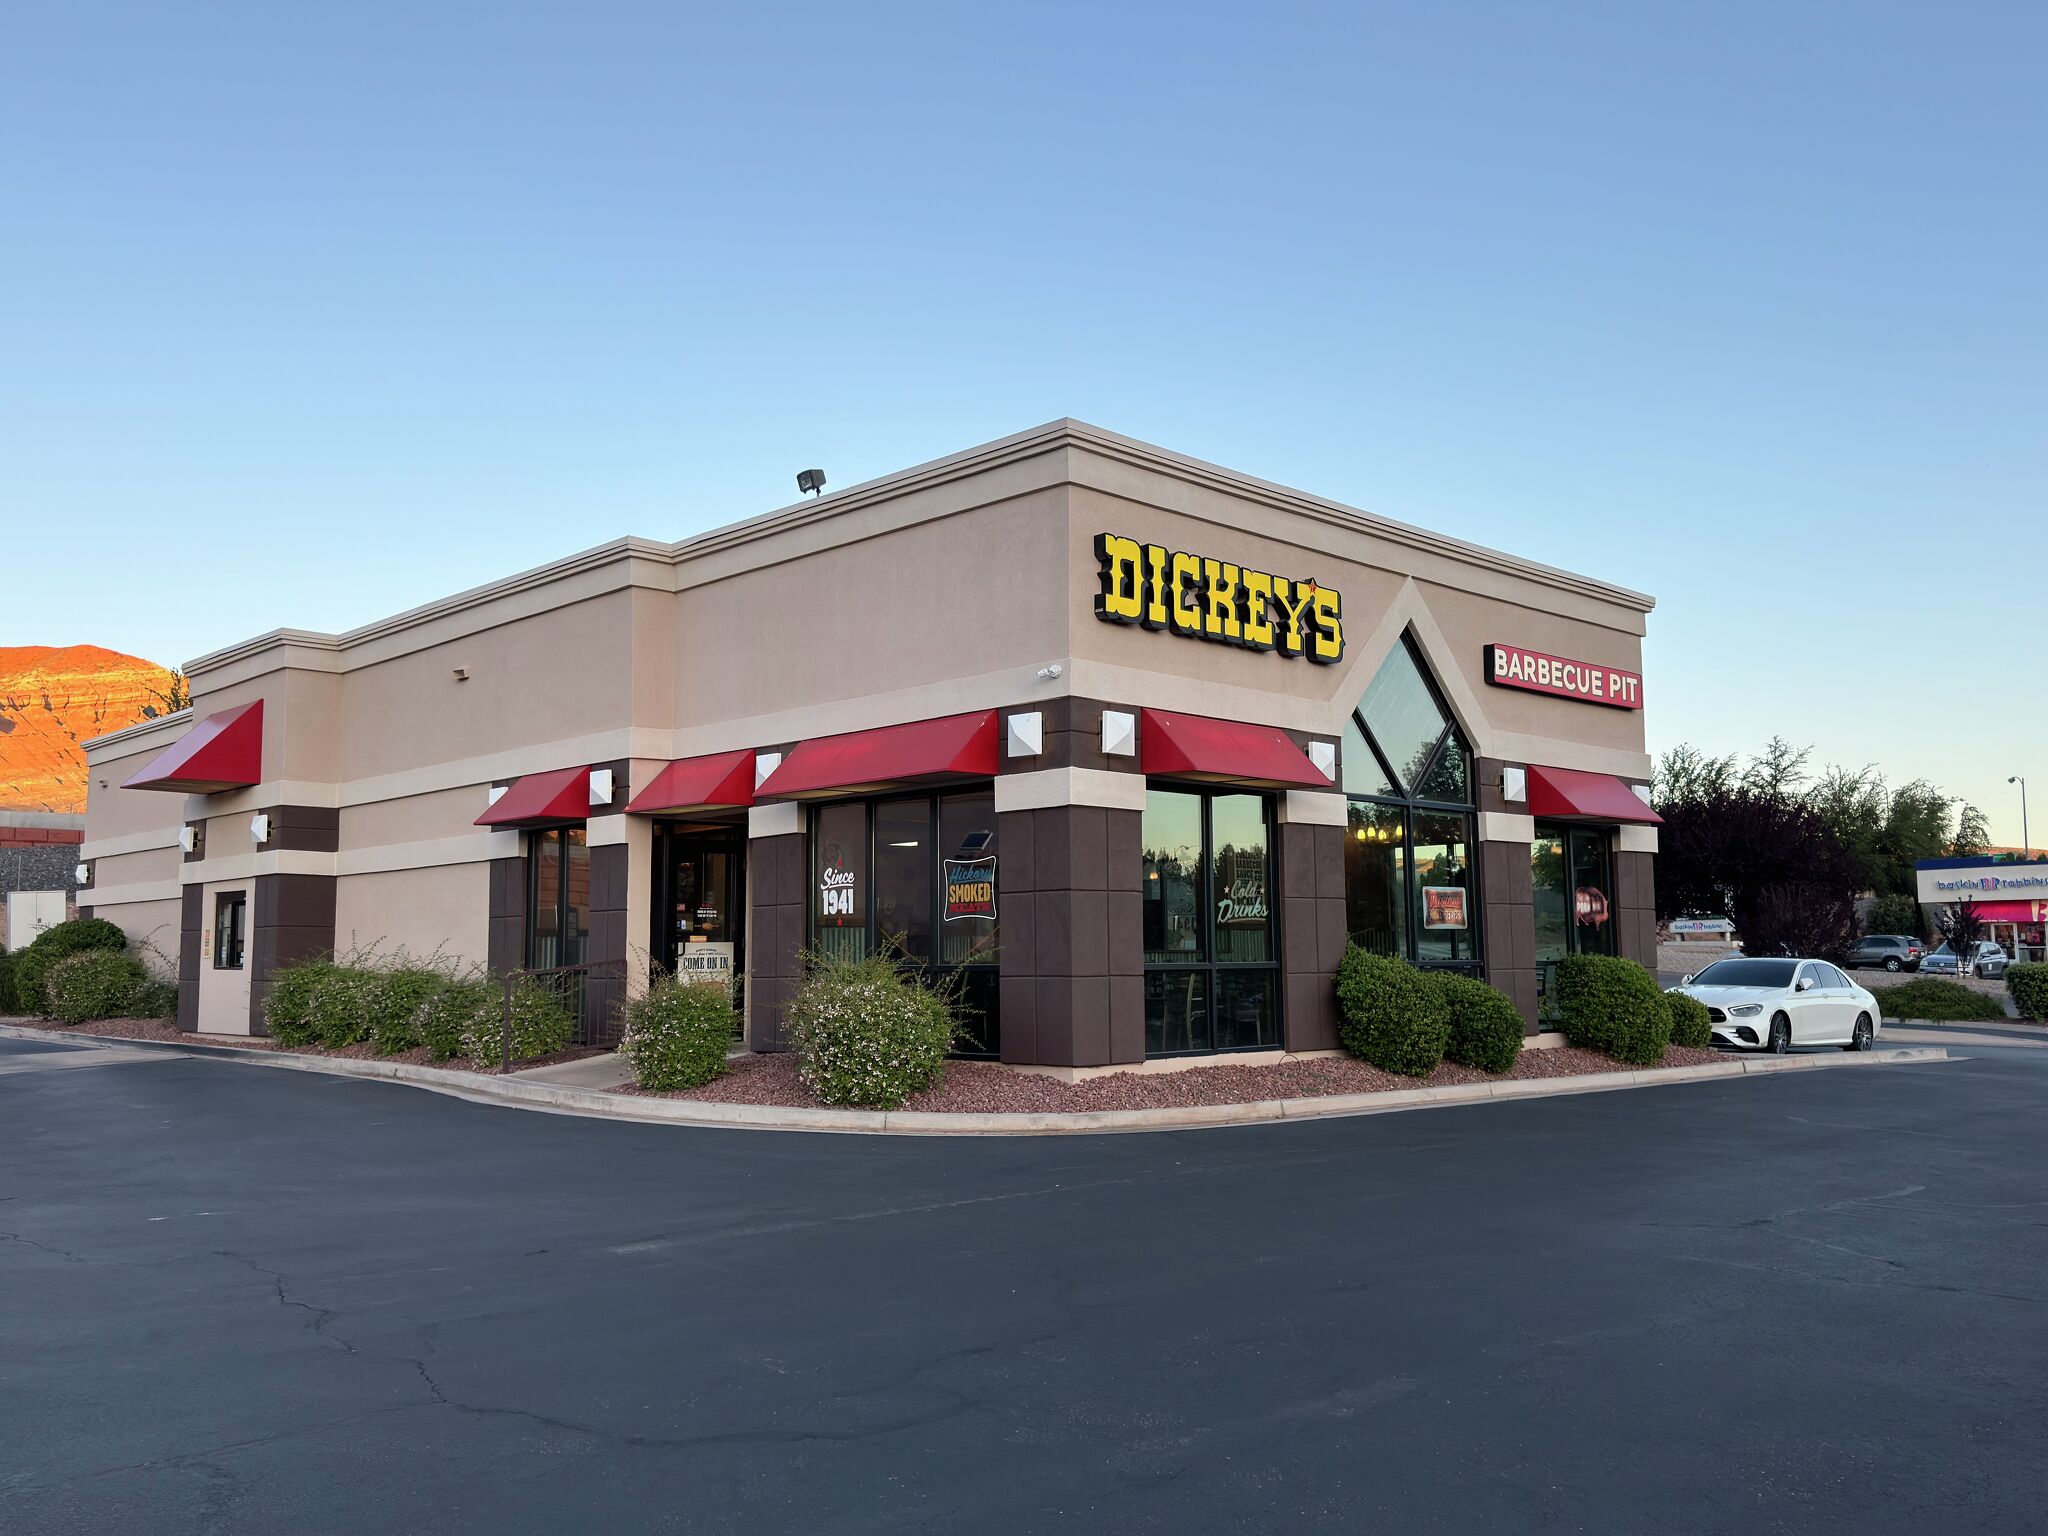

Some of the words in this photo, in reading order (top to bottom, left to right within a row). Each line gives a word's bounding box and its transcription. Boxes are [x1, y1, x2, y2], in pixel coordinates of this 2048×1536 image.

[1495, 648, 1603, 696] BARBECUE
[1609, 673, 1638, 702] PIT
[820, 868, 854, 889] Since
[1937, 879, 1979, 890] baskin
[949, 883, 991, 903] SMOKED
[1231, 880, 1259, 899] Cold
[822, 889, 854, 915] 1941
[1217, 897, 1269, 924] Drinks
[683, 957, 705, 970] COME
[707, 957, 717, 970] ON
[720, 956, 729, 970] IN
